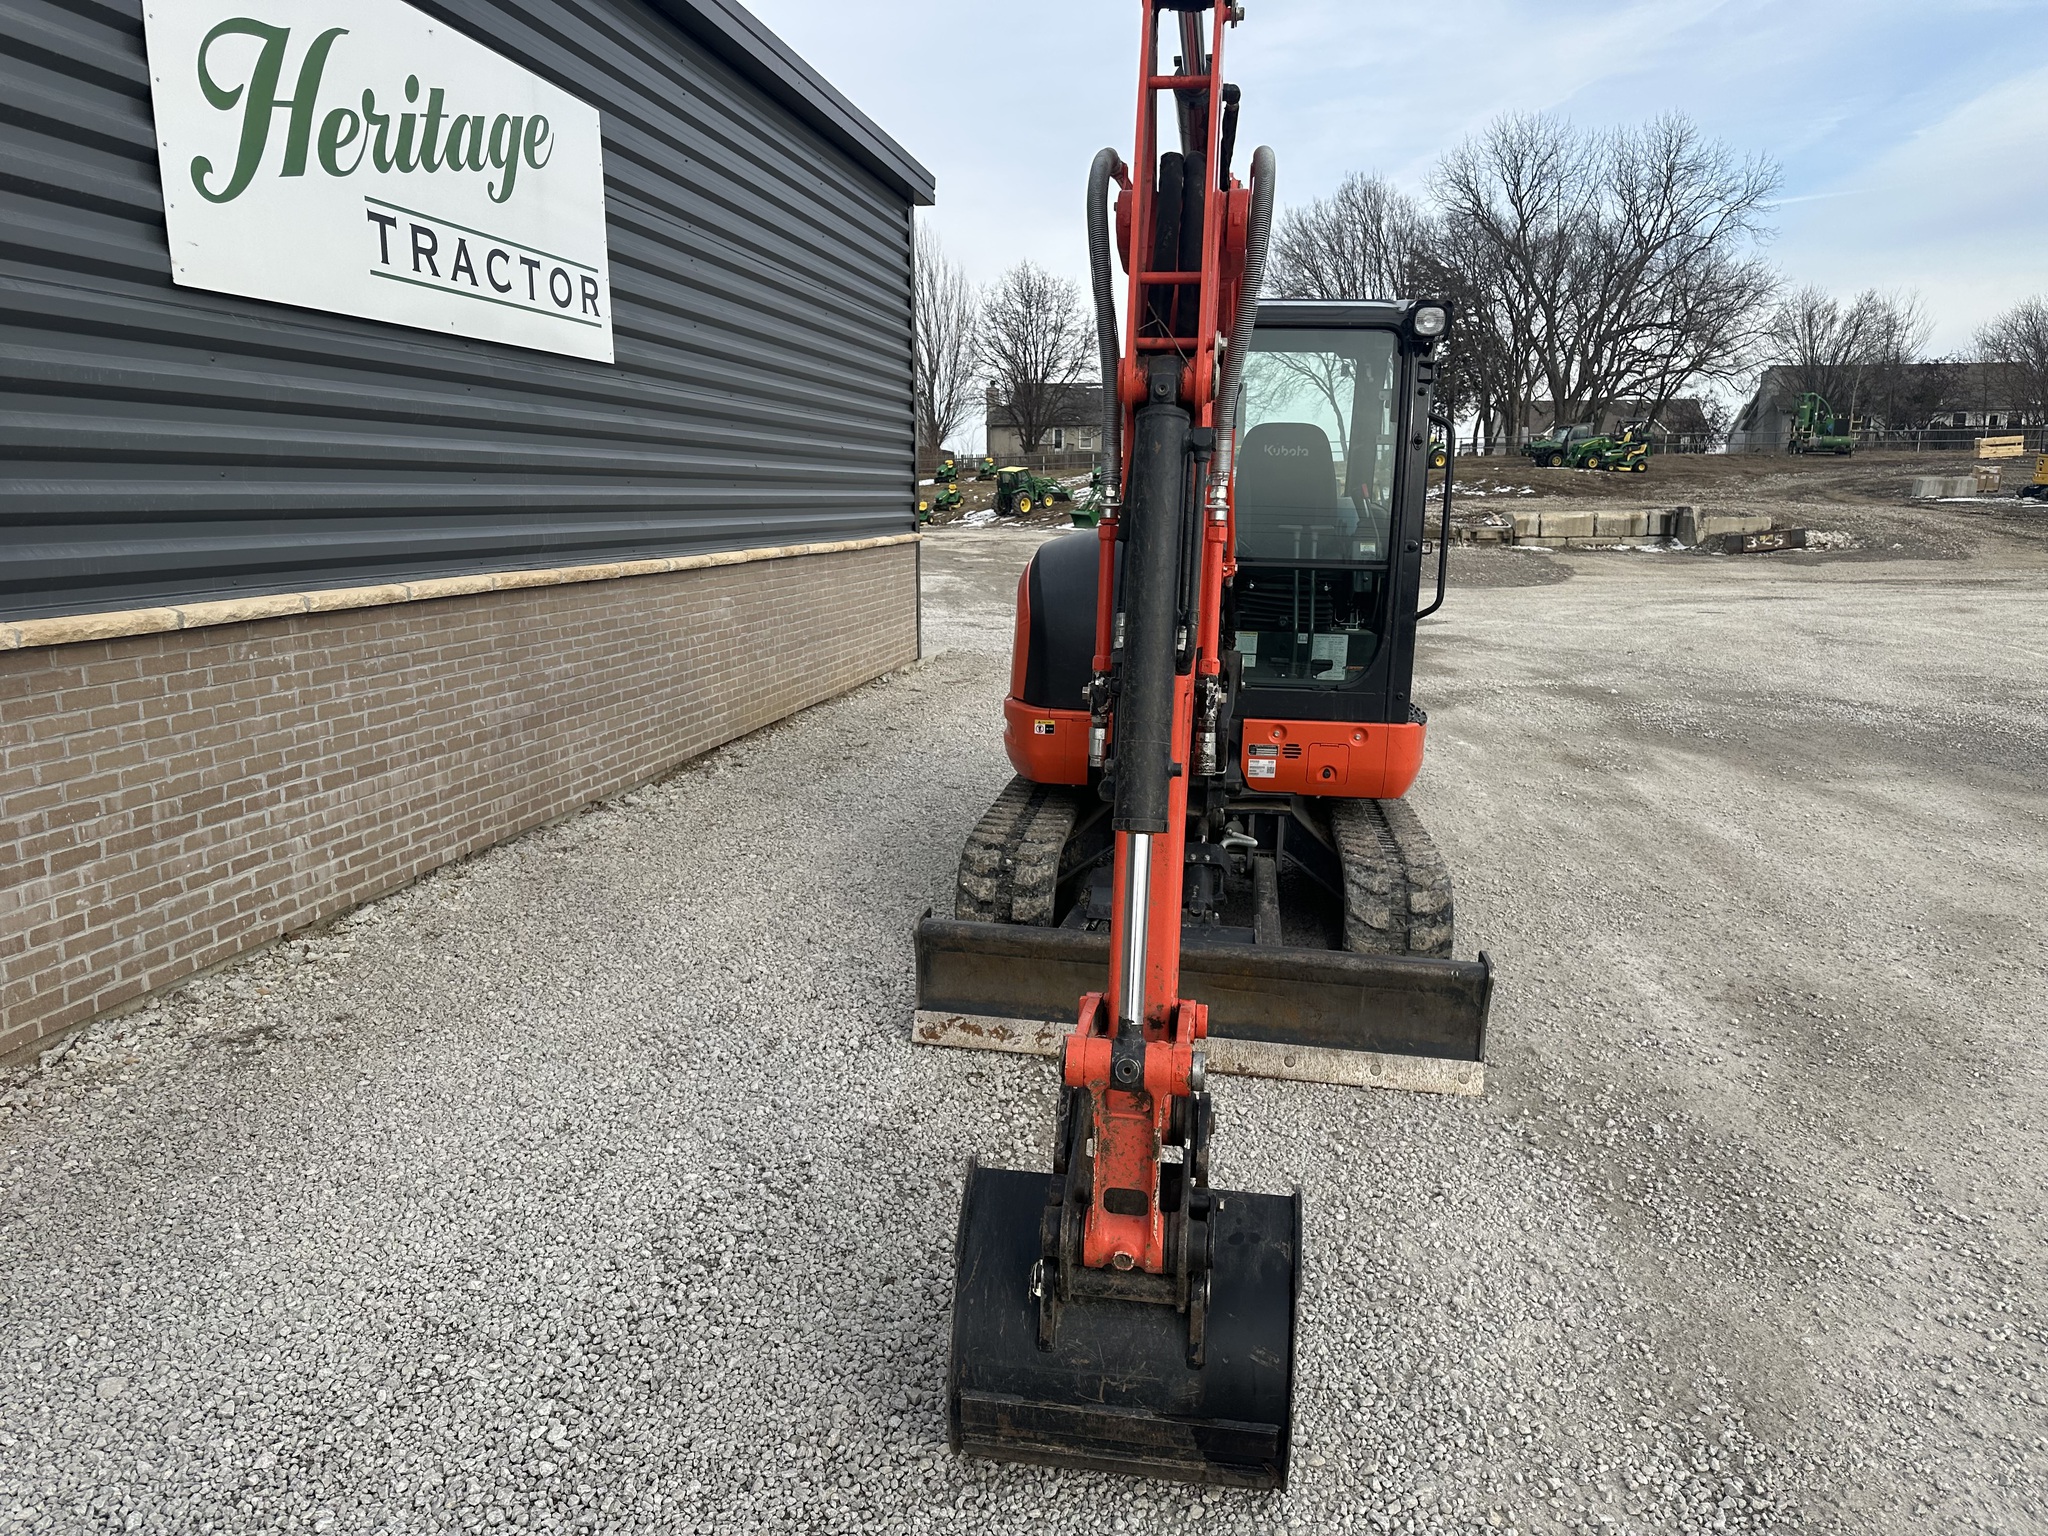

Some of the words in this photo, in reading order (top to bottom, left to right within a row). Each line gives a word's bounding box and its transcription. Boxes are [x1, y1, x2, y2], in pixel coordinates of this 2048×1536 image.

[190, 17, 554, 204] Heritage
[367, 208, 601, 317] TRACTOR
[1264, 444, 1309, 457] Kubota
